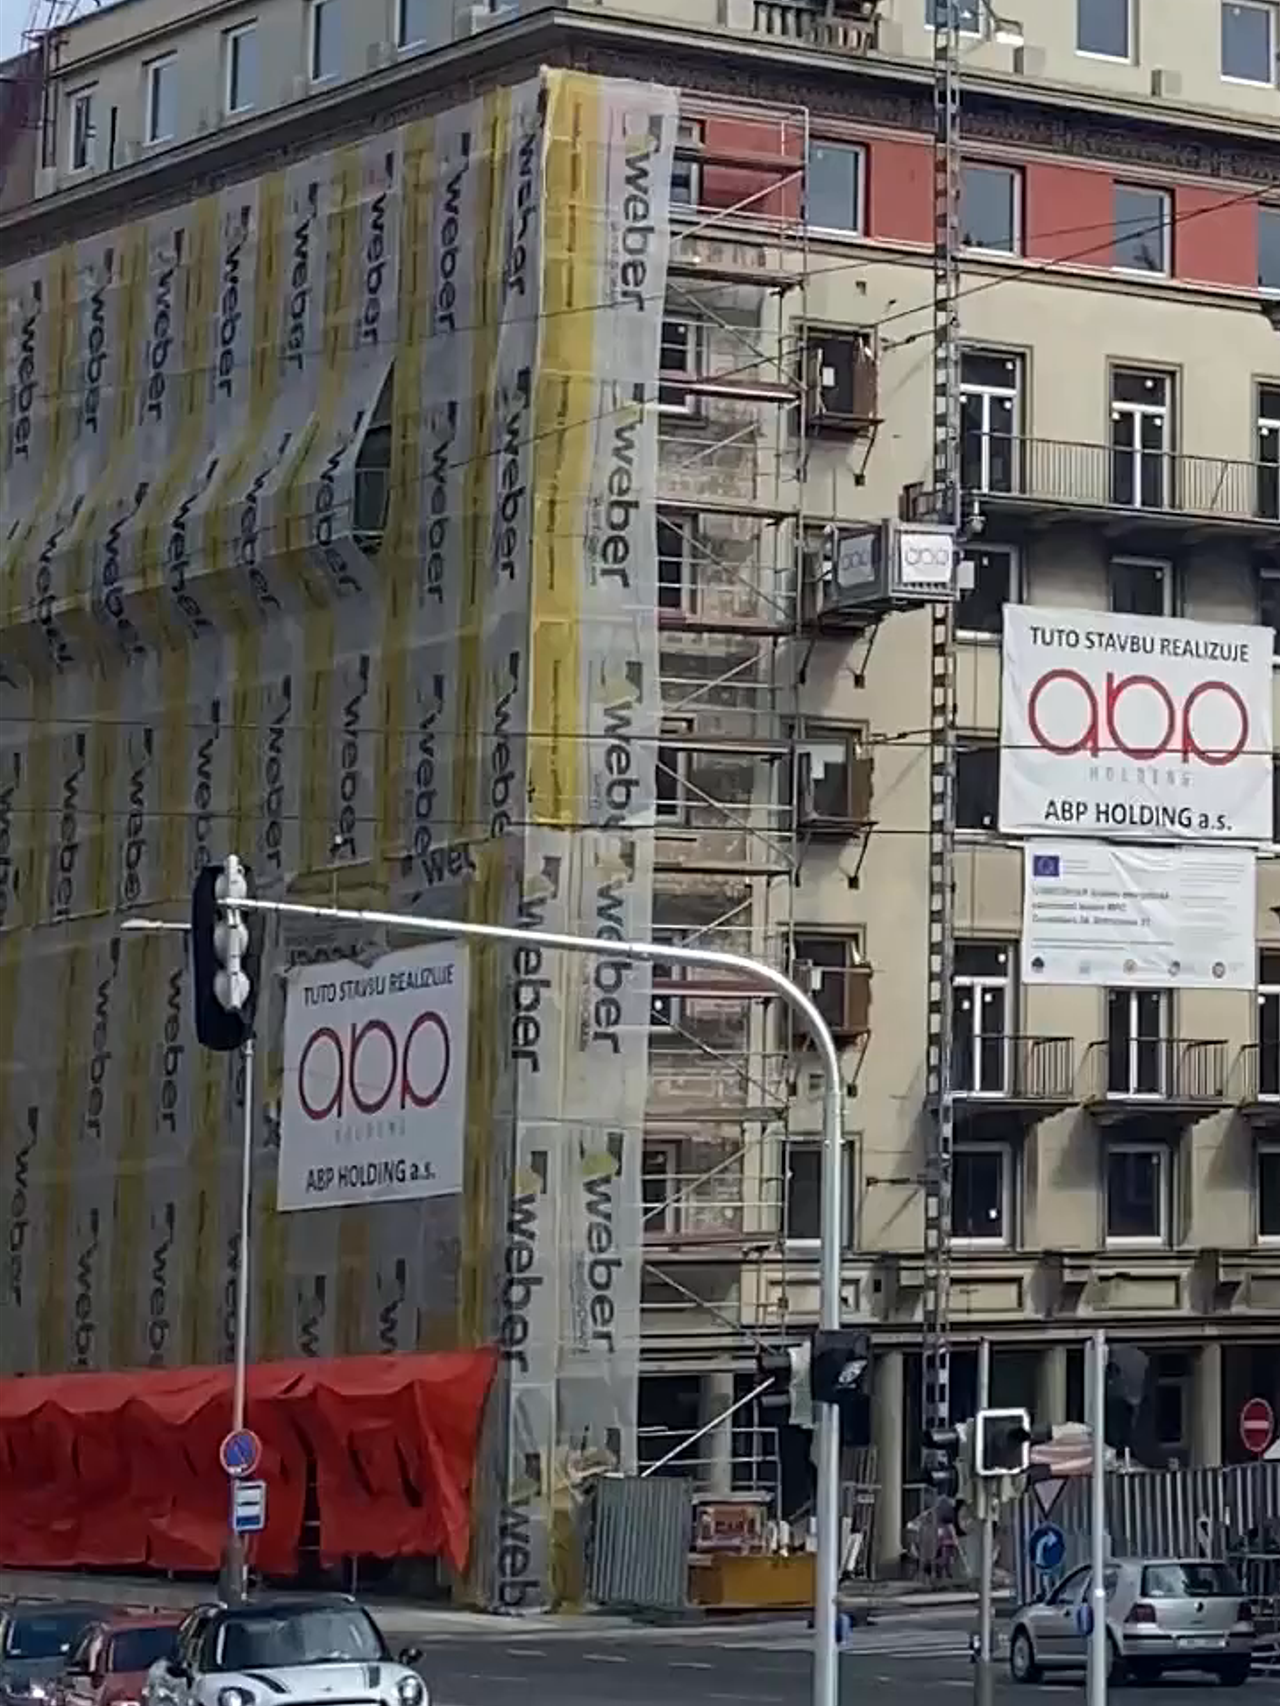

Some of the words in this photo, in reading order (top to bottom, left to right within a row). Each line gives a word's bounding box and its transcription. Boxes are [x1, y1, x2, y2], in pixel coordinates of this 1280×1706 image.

[288, 218, 313, 370] weber
[361, 191, 390, 347] weber
[437, 168, 467, 328] weber
[621, 147, 655, 313] weber
[15, 316, 38, 462] weber
[84, 285, 109, 434] weber
[147, 267, 175, 422] weber
[217, 242, 243, 398] weber
[314, 443, 363, 592] weber
[426, 439, 450, 604] weber
[500, 412, 527, 581] weber
[600, 422, 640, 588] weber
[1030, 625, 1080, 648] TUTO
[1085, 630, 1155, 655] STAVBU
[1159, 637, 1250, 663] REALIZUJE
[263, 712, 288, 870] weber
[337, 695, 362, 859] weber
[490, 690, 516, 838] webe
[1045, 799, 1089, 822] ABP
[1095, 801, 1193, 829] HOLDING
[1198, 812, 1233, 832] a.s.
[86, 979, 113, 1138] weber
[161, 968, 185, 1132] weber
[304, 982, 337, 1008] TUTO
[305, 1165, 336, 1193] ABP
[338, 1158, 406, 1189] HOLDING
[502, 1193, 543, 1373] weber
[583, 1173, 622, 1354] weber
